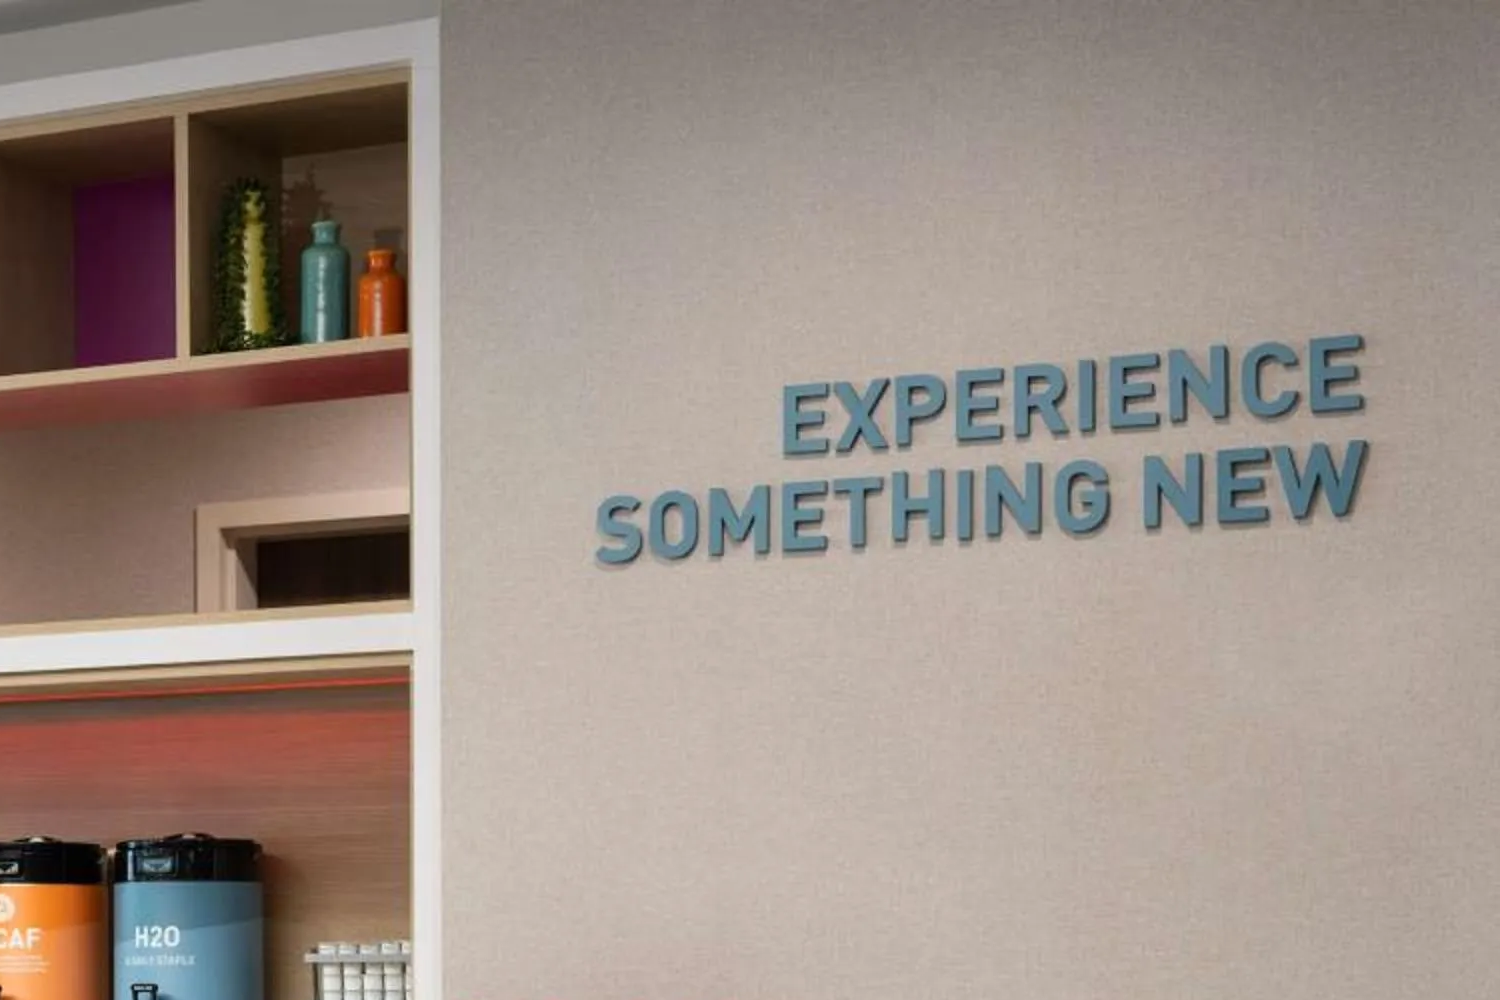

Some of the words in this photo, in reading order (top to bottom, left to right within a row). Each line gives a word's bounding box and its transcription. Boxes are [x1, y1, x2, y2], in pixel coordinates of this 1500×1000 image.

[782, 334, 1365, 456] EXPERIENCE
[595, 458, 1110, 566] SOMETHING
[1143, 439, 1369, 530] NEW
[135, 925, 181, 948] H2O
